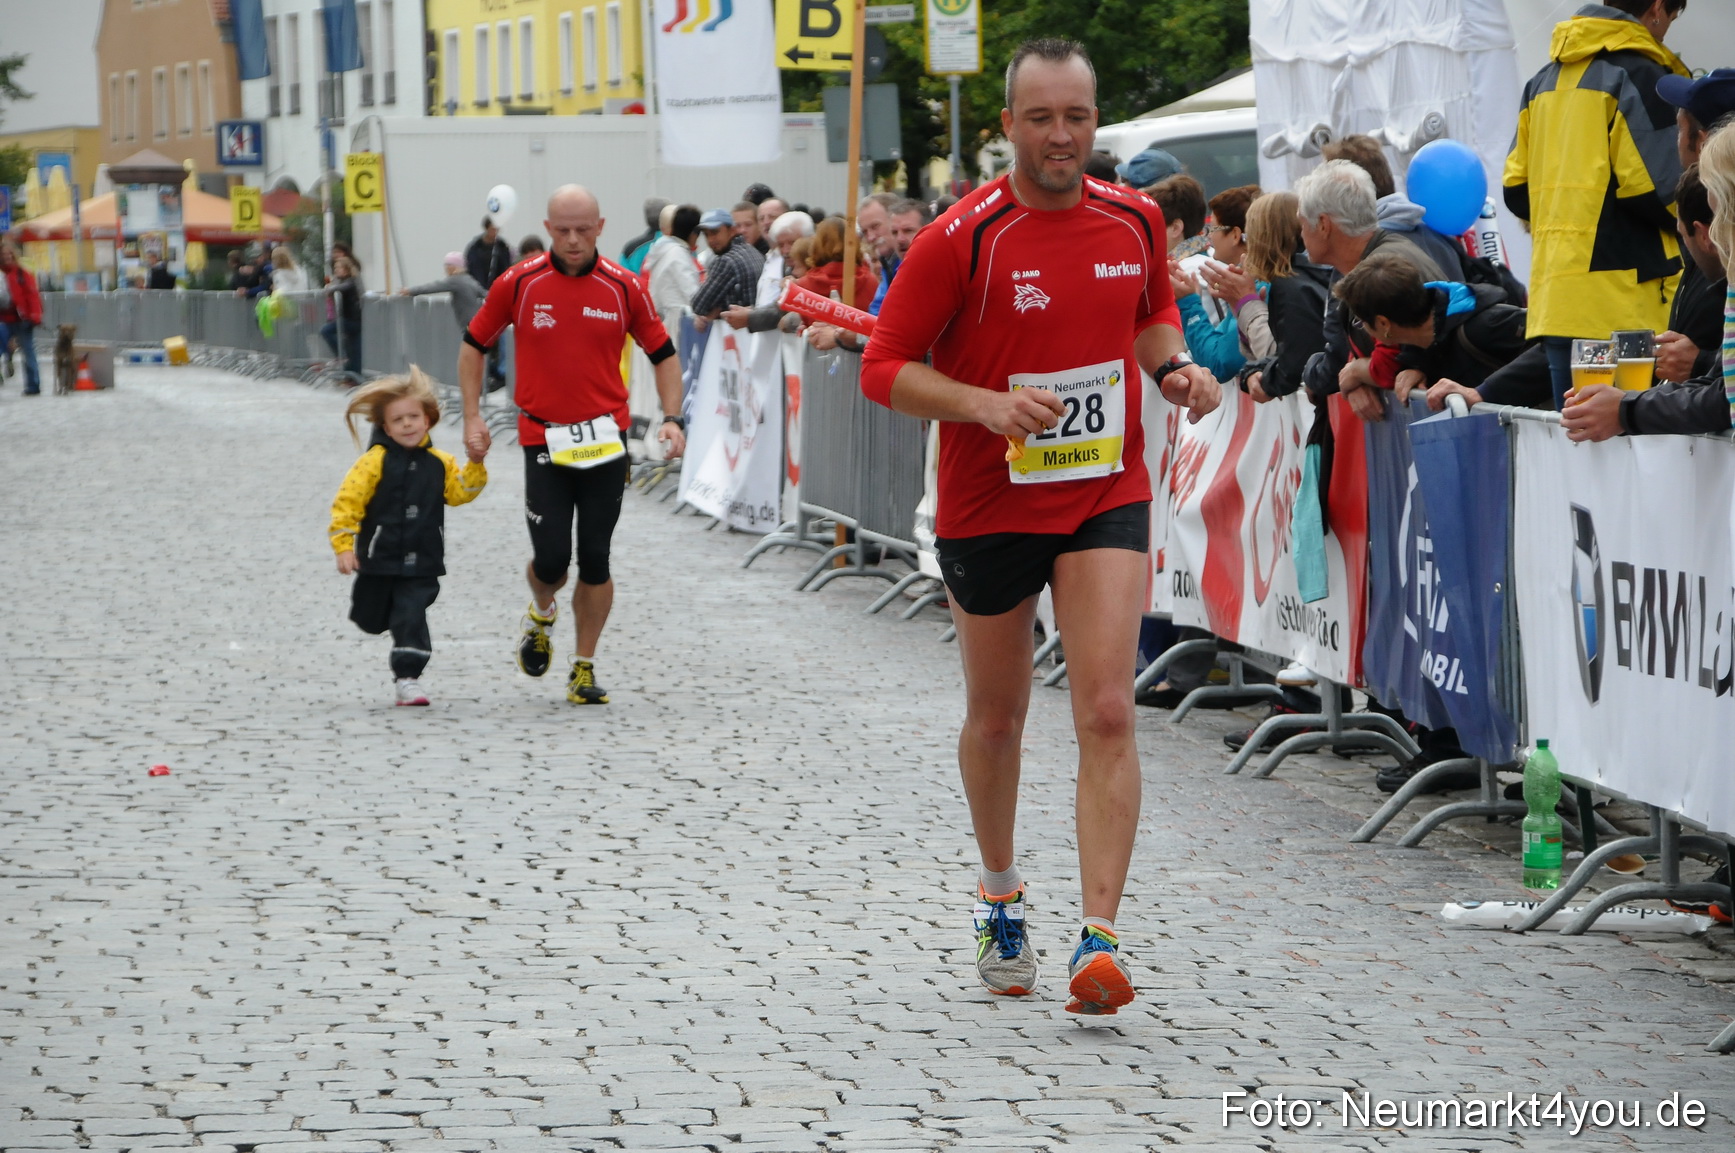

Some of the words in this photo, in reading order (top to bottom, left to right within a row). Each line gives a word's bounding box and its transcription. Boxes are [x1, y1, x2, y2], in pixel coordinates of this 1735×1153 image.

[347, 155, 379, 167] Block
[354, 170, 374, 199] C
[239, 200, 254, 221] D
[1022, 269, 1041, 278] JAKO
[1094, 260, 1142, 279] Markus
[582, 306, 618, 321] Robert
[792, 291, 831, 313] Audi
[832, 305, 866, 327] BKK
[1054, 375, 1107, 394] Neumarkt
[1035, 392, 1106, 441] 28
[569, 420, 597, 444] 91
[571, 447, 603, 460] Robert
[1043, 447, 1101, 467] Markus
